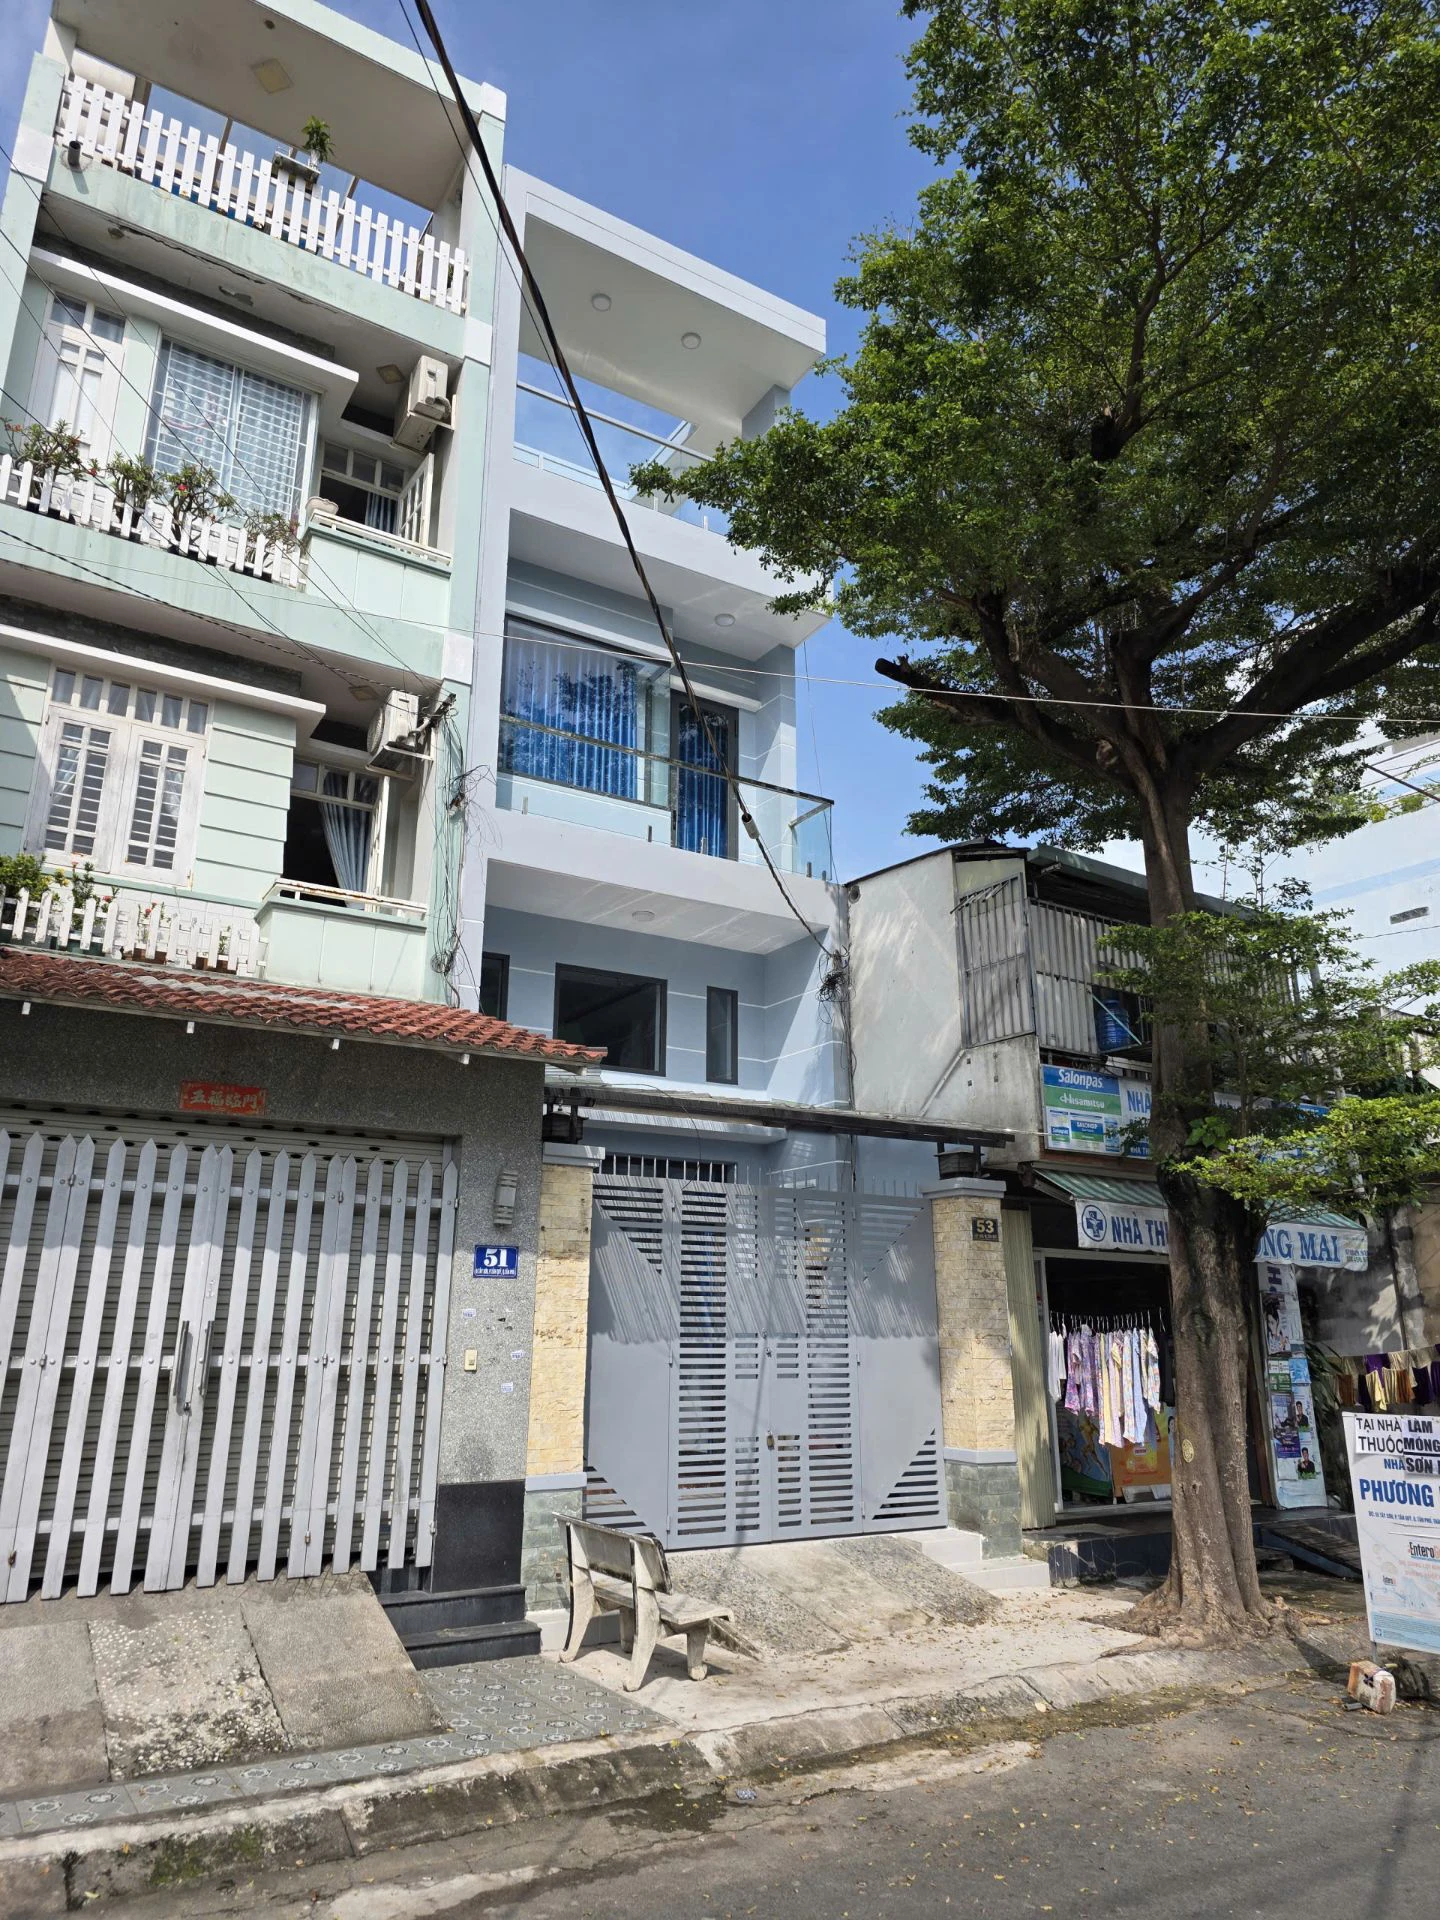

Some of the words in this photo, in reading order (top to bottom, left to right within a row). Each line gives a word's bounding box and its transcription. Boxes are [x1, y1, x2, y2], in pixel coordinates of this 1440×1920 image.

[1058, 1069, 1103, 1089] Salonpas
[1060, 1093, 1105, 1109] Hisamitsu
[1127, 1087, 1151, 1114] NHÀ
[976, 1219, 995, 1234] 53
[1111, 1211, 1143, 1245] NHÀ
[1297, 1231, 1340, 1262] MAI
[483, 1248, 508, 1268] 51
[1356, 1417, 1374, 1433] TẠI
[1377, 1417, 1403, 1433] NHÀ
[1408, 1418, 1433, 1433] LÀM
[1358, 1434, 1404, 1453] THUỐC
[1403, 1437, 1440, 1452] MÓNG
[1406, 1457, 1433, 1474] SƠN
[1360, 1479, 1434, 1507] PHƯƠNG
[1409, 1541, 1440, 1560] Entero
